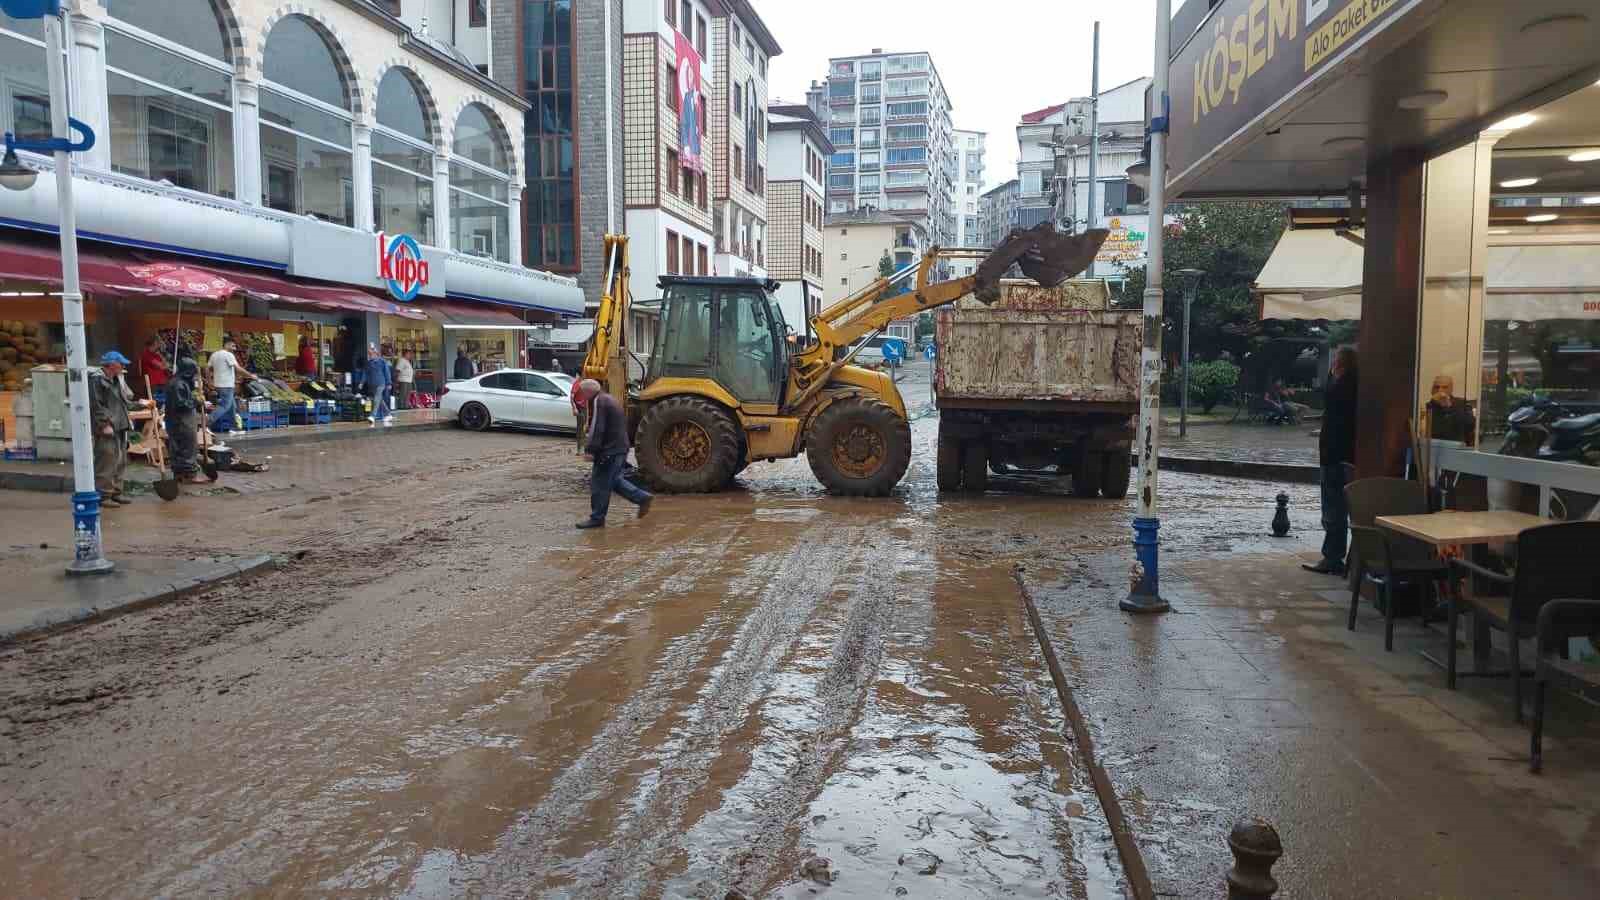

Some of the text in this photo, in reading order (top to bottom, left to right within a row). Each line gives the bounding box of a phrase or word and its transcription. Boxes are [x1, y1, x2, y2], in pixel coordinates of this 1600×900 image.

[1192, 0, 1299, 124] KÖŞEM
[1312, 34, 1330, 61] Alo
[1332, 2, 1368, 45] Paket
